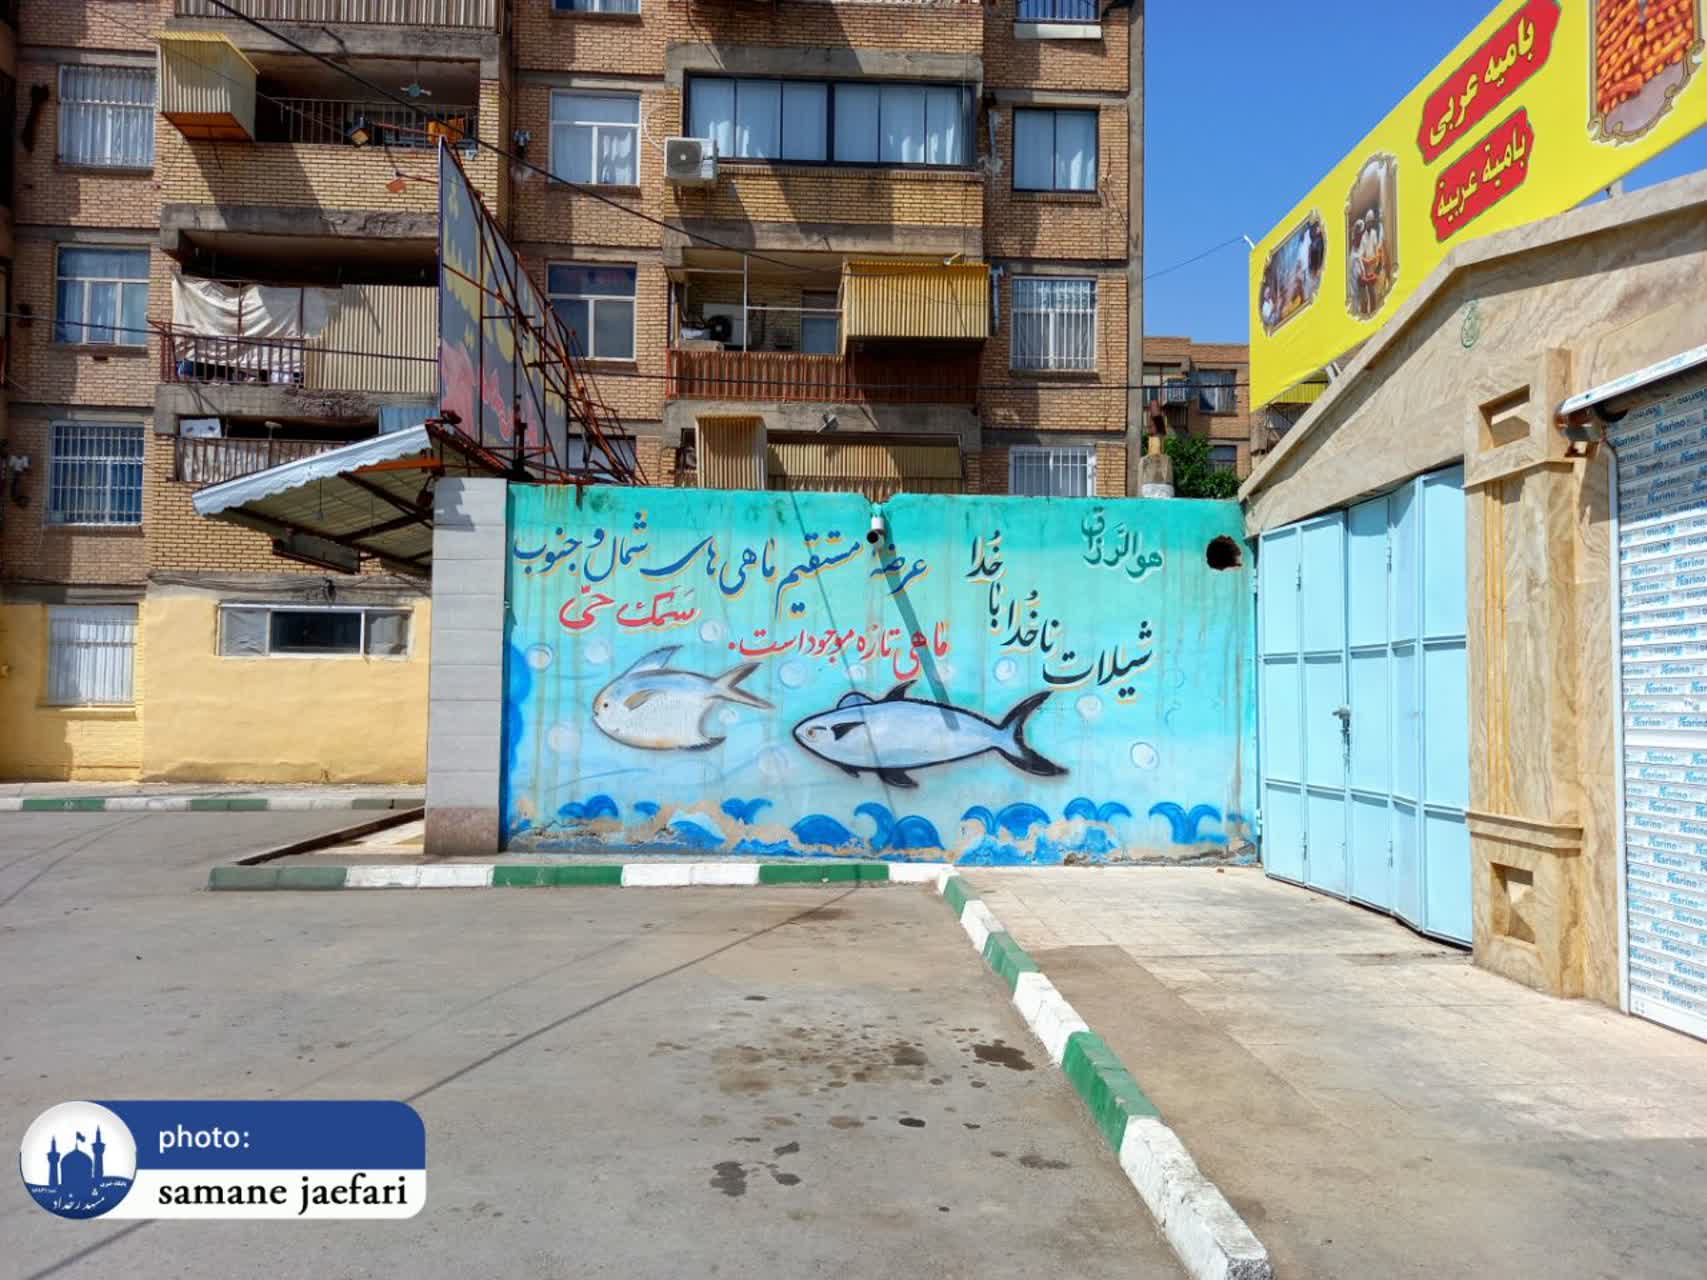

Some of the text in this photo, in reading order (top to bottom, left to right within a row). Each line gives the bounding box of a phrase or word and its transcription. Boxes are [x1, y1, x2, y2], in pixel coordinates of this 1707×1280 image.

[1430, 16, 1535, 146] بامیه عربی
[512, 527, 584, 575] جنوب
[584, 511, 648, 583] شمال
[586, 527, 605, 549] و
[718, 537, 776, 596] ماهی
[775, 530, 861, 619] مستقیم
[869, 543, 929, 595] عرضه
[989, 581, 1001, 628] با
[804, 628, 855, 663] موجود
[857, 623, 900, 661] تازه
[893, 621, 949, 681] ماهی
[1043, 620, 1152, 698] شیلات
